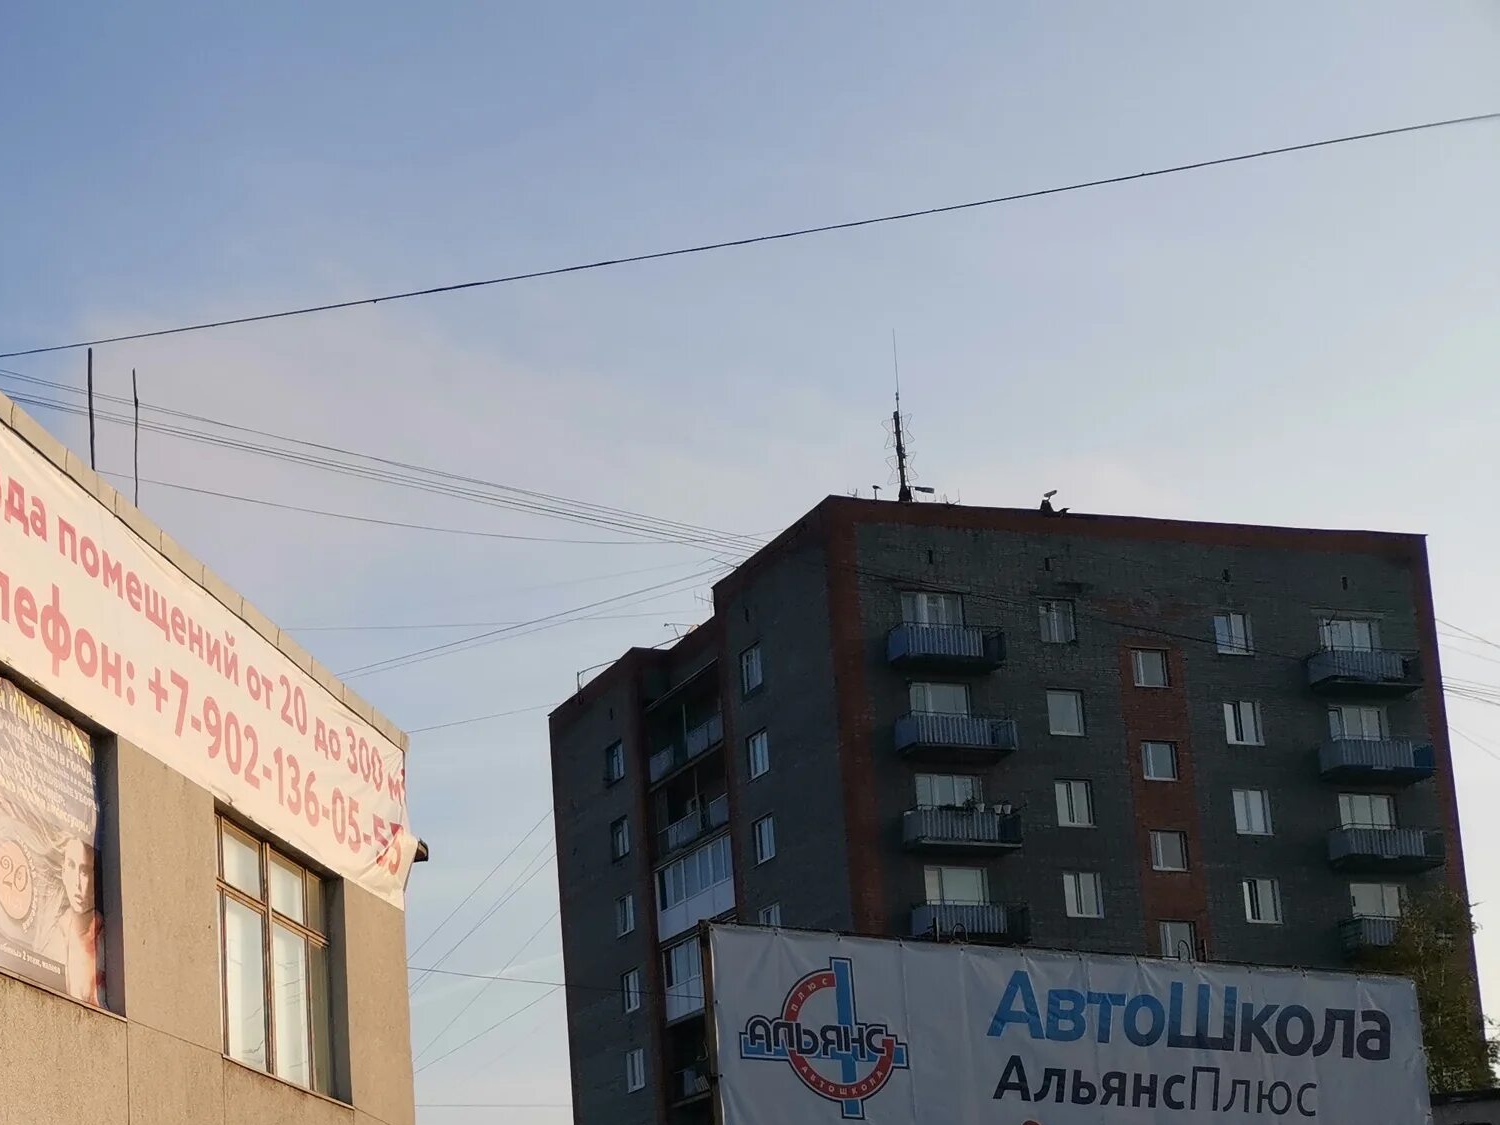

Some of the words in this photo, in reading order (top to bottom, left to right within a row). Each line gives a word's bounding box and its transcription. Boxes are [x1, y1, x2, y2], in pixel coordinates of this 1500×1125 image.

[58, 520, 241, 688] помещений
[246, 664, 275, 710] от
[279, 673, 308, 738] 20
[314, 716, 343, 762] до
[346, 724, 386, 792] 300
[0, 855, 28, 892] 20
[986, 969, 1392, 1061] АвтоШкола
[802, 1065, 884, 1096] АВТОШКОЛА
[993, 1055, 1318, 1117] АльянсПлюс
